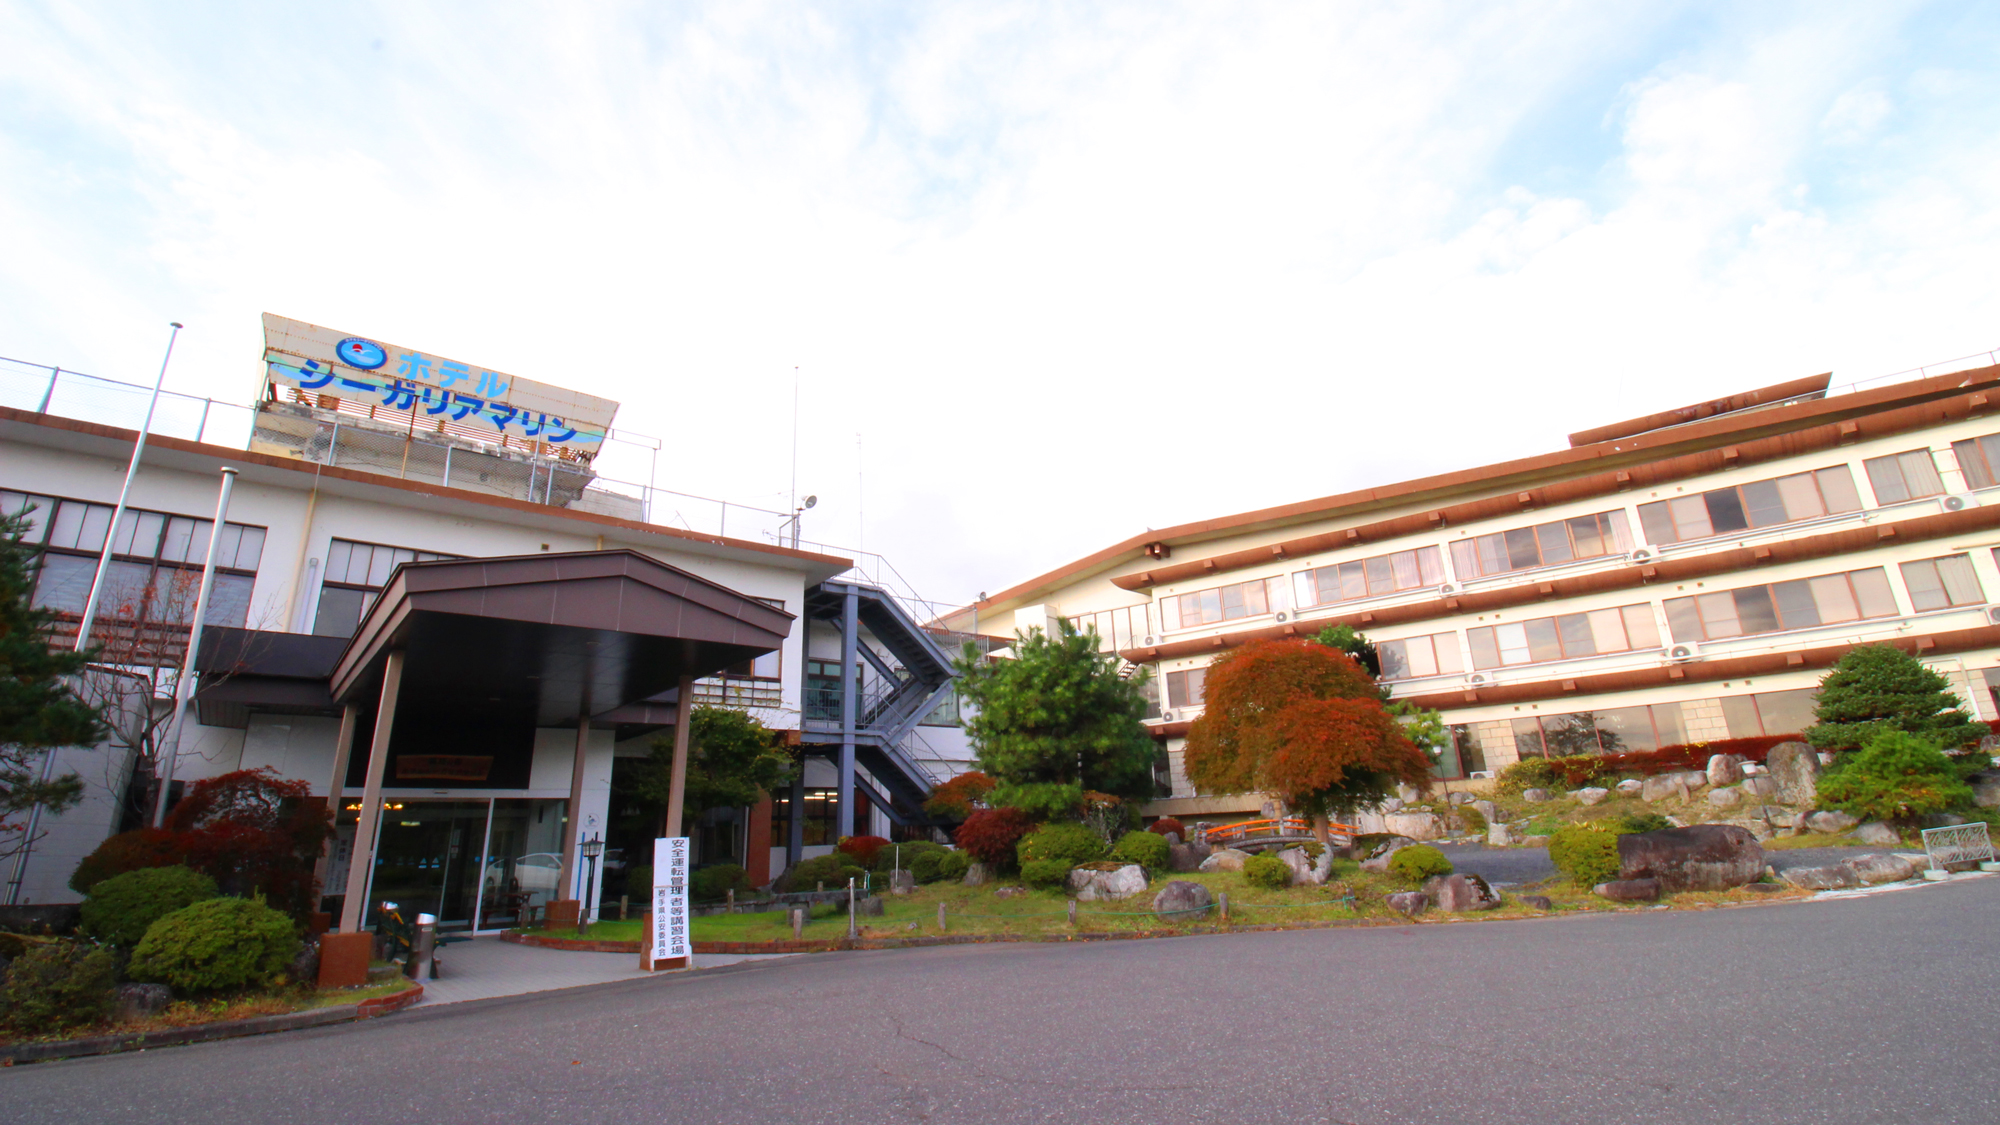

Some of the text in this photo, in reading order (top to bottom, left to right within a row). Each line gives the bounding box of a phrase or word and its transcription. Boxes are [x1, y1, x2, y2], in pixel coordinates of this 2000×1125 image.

[299, 359, 578, 442] シーガリアマリン
[397, 352, 509, 398] ホテル
[658, 889, 666, 957] 岩手県公安委員会
[670, 839, 685, 955] 安全運転管理者等講習会場
